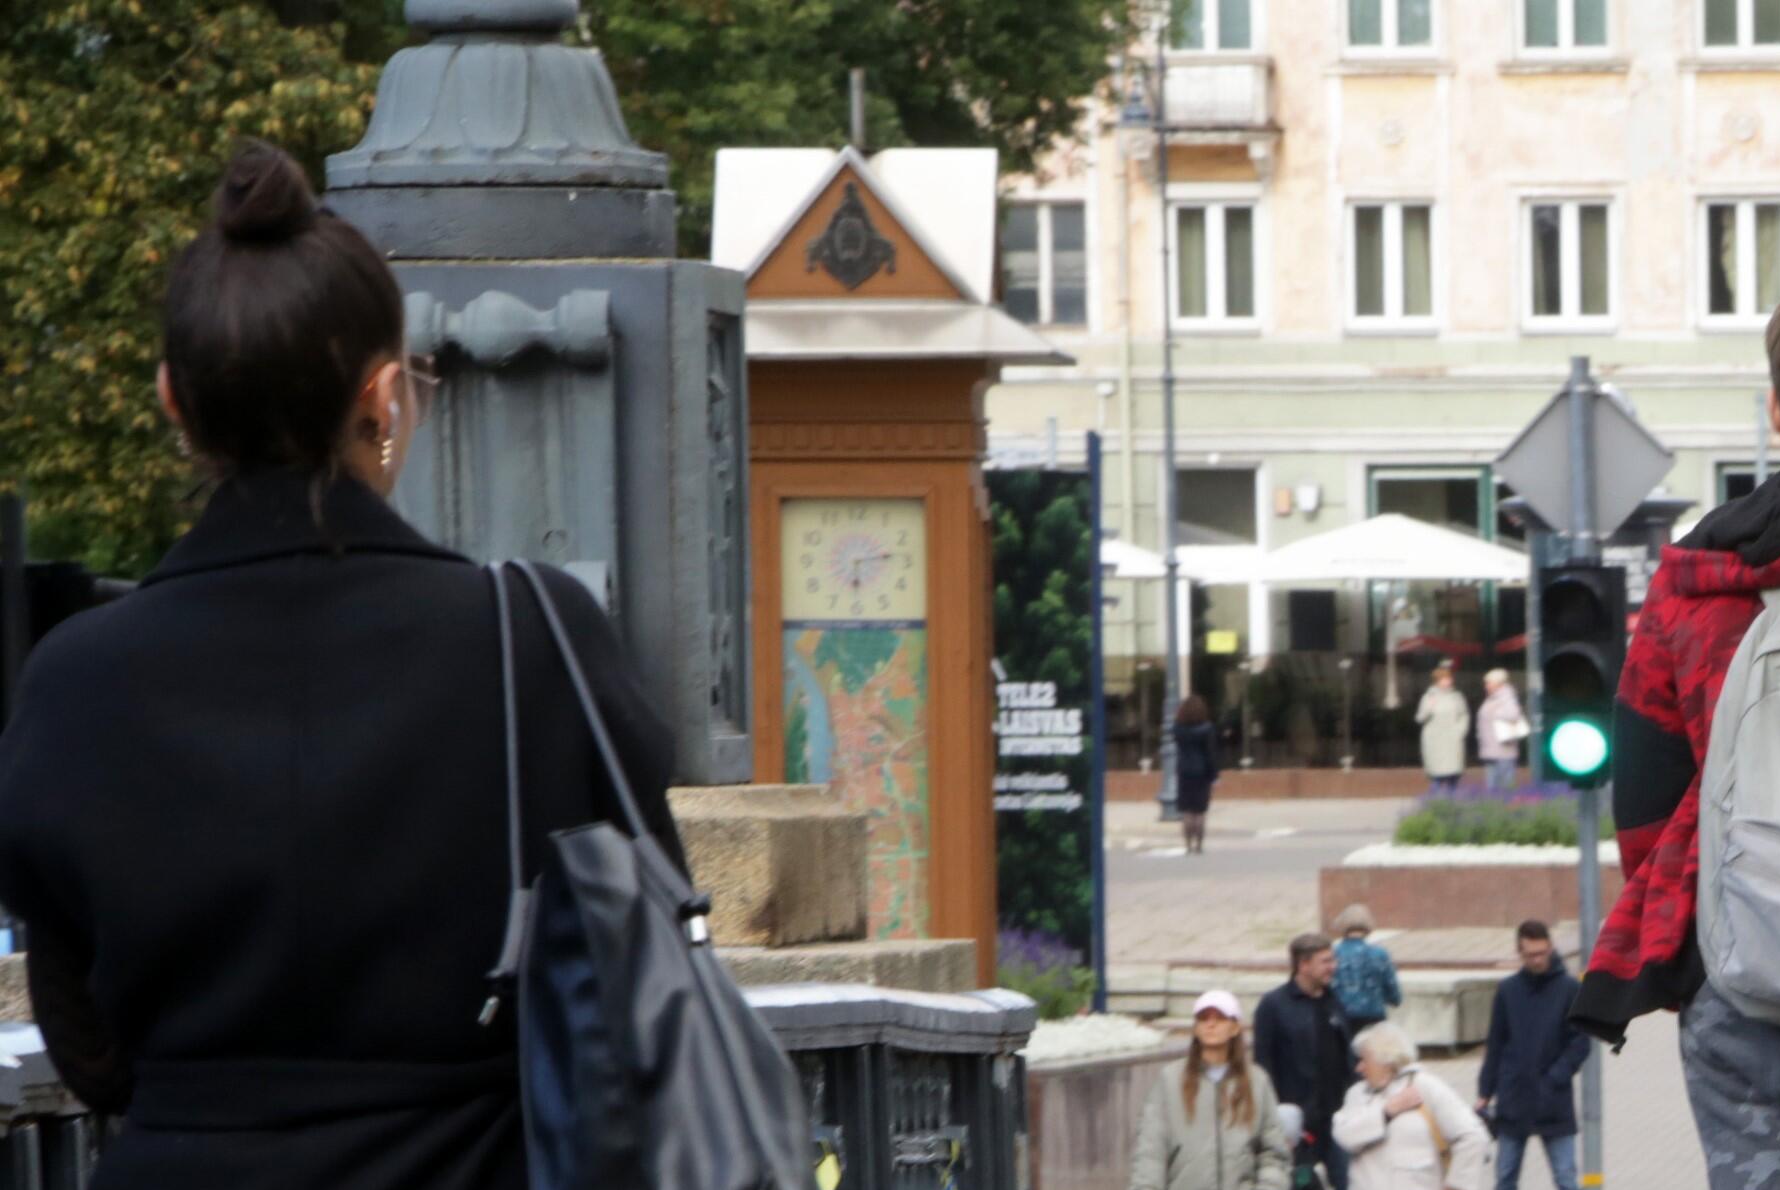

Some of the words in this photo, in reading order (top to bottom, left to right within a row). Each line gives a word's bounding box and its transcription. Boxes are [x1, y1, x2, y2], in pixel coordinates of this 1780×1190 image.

[849, 504, 868, 521] 12
[804, 529, 822, 545] 10
[896, 529, 908, 545] 2
